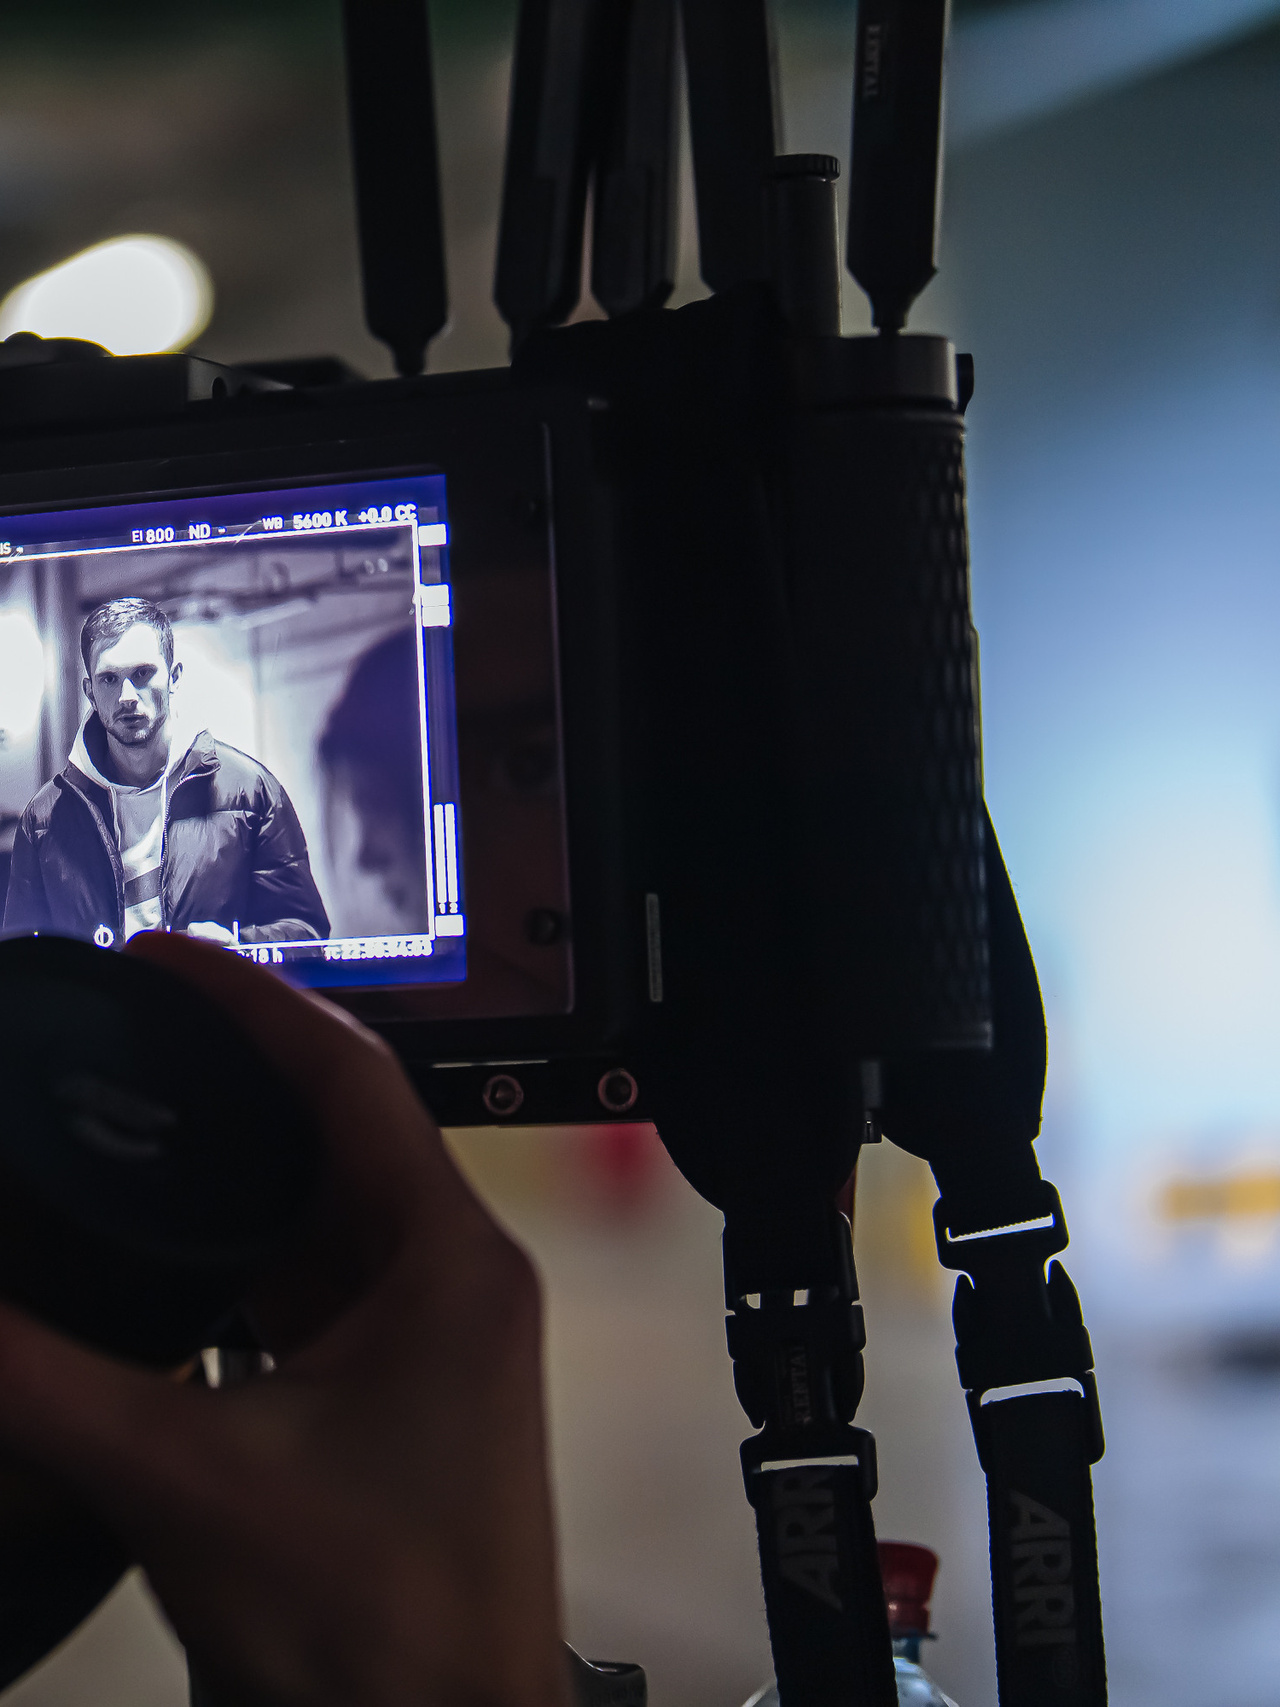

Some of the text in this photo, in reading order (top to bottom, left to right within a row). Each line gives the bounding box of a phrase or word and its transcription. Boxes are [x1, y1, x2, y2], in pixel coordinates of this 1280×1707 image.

[262, 516, 283, 530] WB
[292, 512, 332, 530] 5600
[335, 510, 348, 526] K
[394, 503, 417, 521] CC
[145, 526, 175, 543] 800
[189, 523, 211, 539] ND
[1009, 1489, 1077, 1647] ARRI
